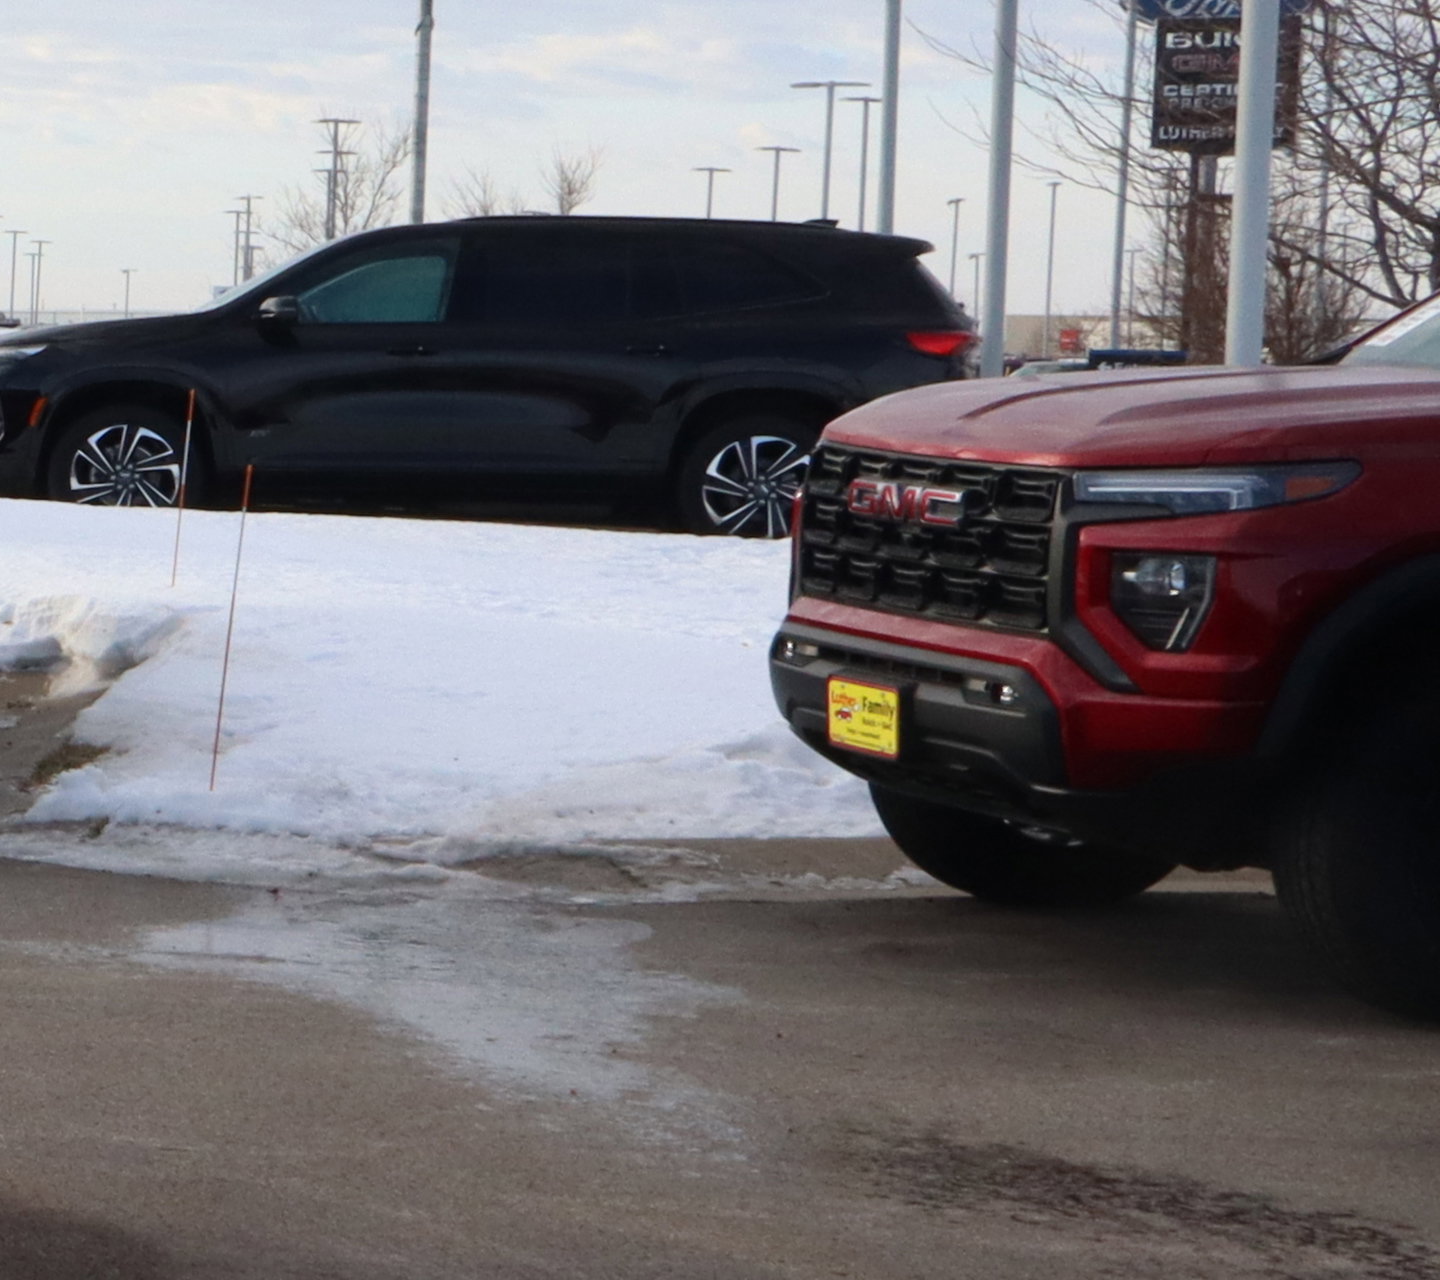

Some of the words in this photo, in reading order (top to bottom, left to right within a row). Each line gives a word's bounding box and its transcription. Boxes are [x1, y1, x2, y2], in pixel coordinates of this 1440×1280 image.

[1165, 32, 1280, 49] BUI
[1172, 54, 1258, 73] GM
[1163, 83, 1284, 97] CERTI
[847, 478, 964, 527] GMC
